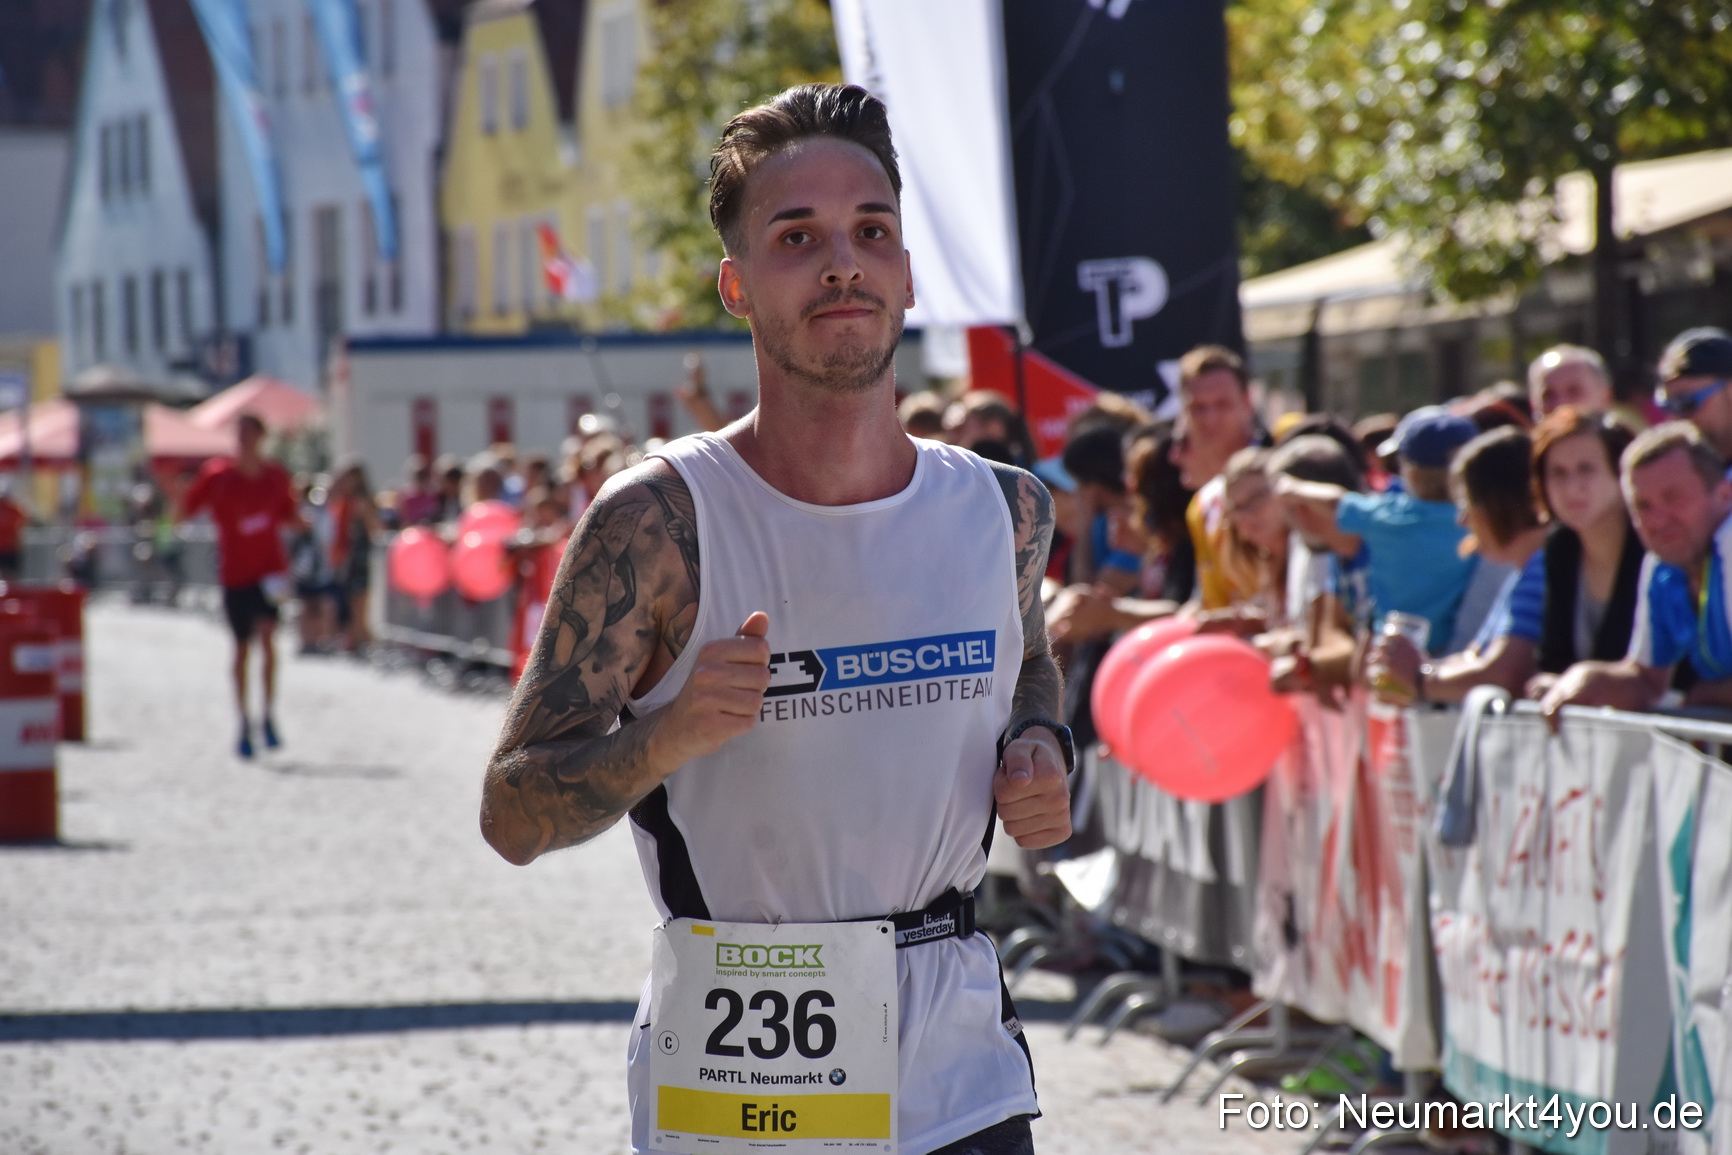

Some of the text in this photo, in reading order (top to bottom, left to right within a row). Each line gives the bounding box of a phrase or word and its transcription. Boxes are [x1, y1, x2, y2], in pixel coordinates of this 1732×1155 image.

[836, 639, 993, 680] BÜSCHEL
[759, 676, 993, 722] FEINSCHNEIDTEAM
[903, 921, 955, 944] yesterday.
[716, 942, 825, 968] BOCK
[715, 967, 826, 979] inspired by smart concepts
[704, 987, 837, 1060] 236
[699, 1067, 823, 1085] PARTL Neumarkt
[741, 1102, 797, 1132] Eric
